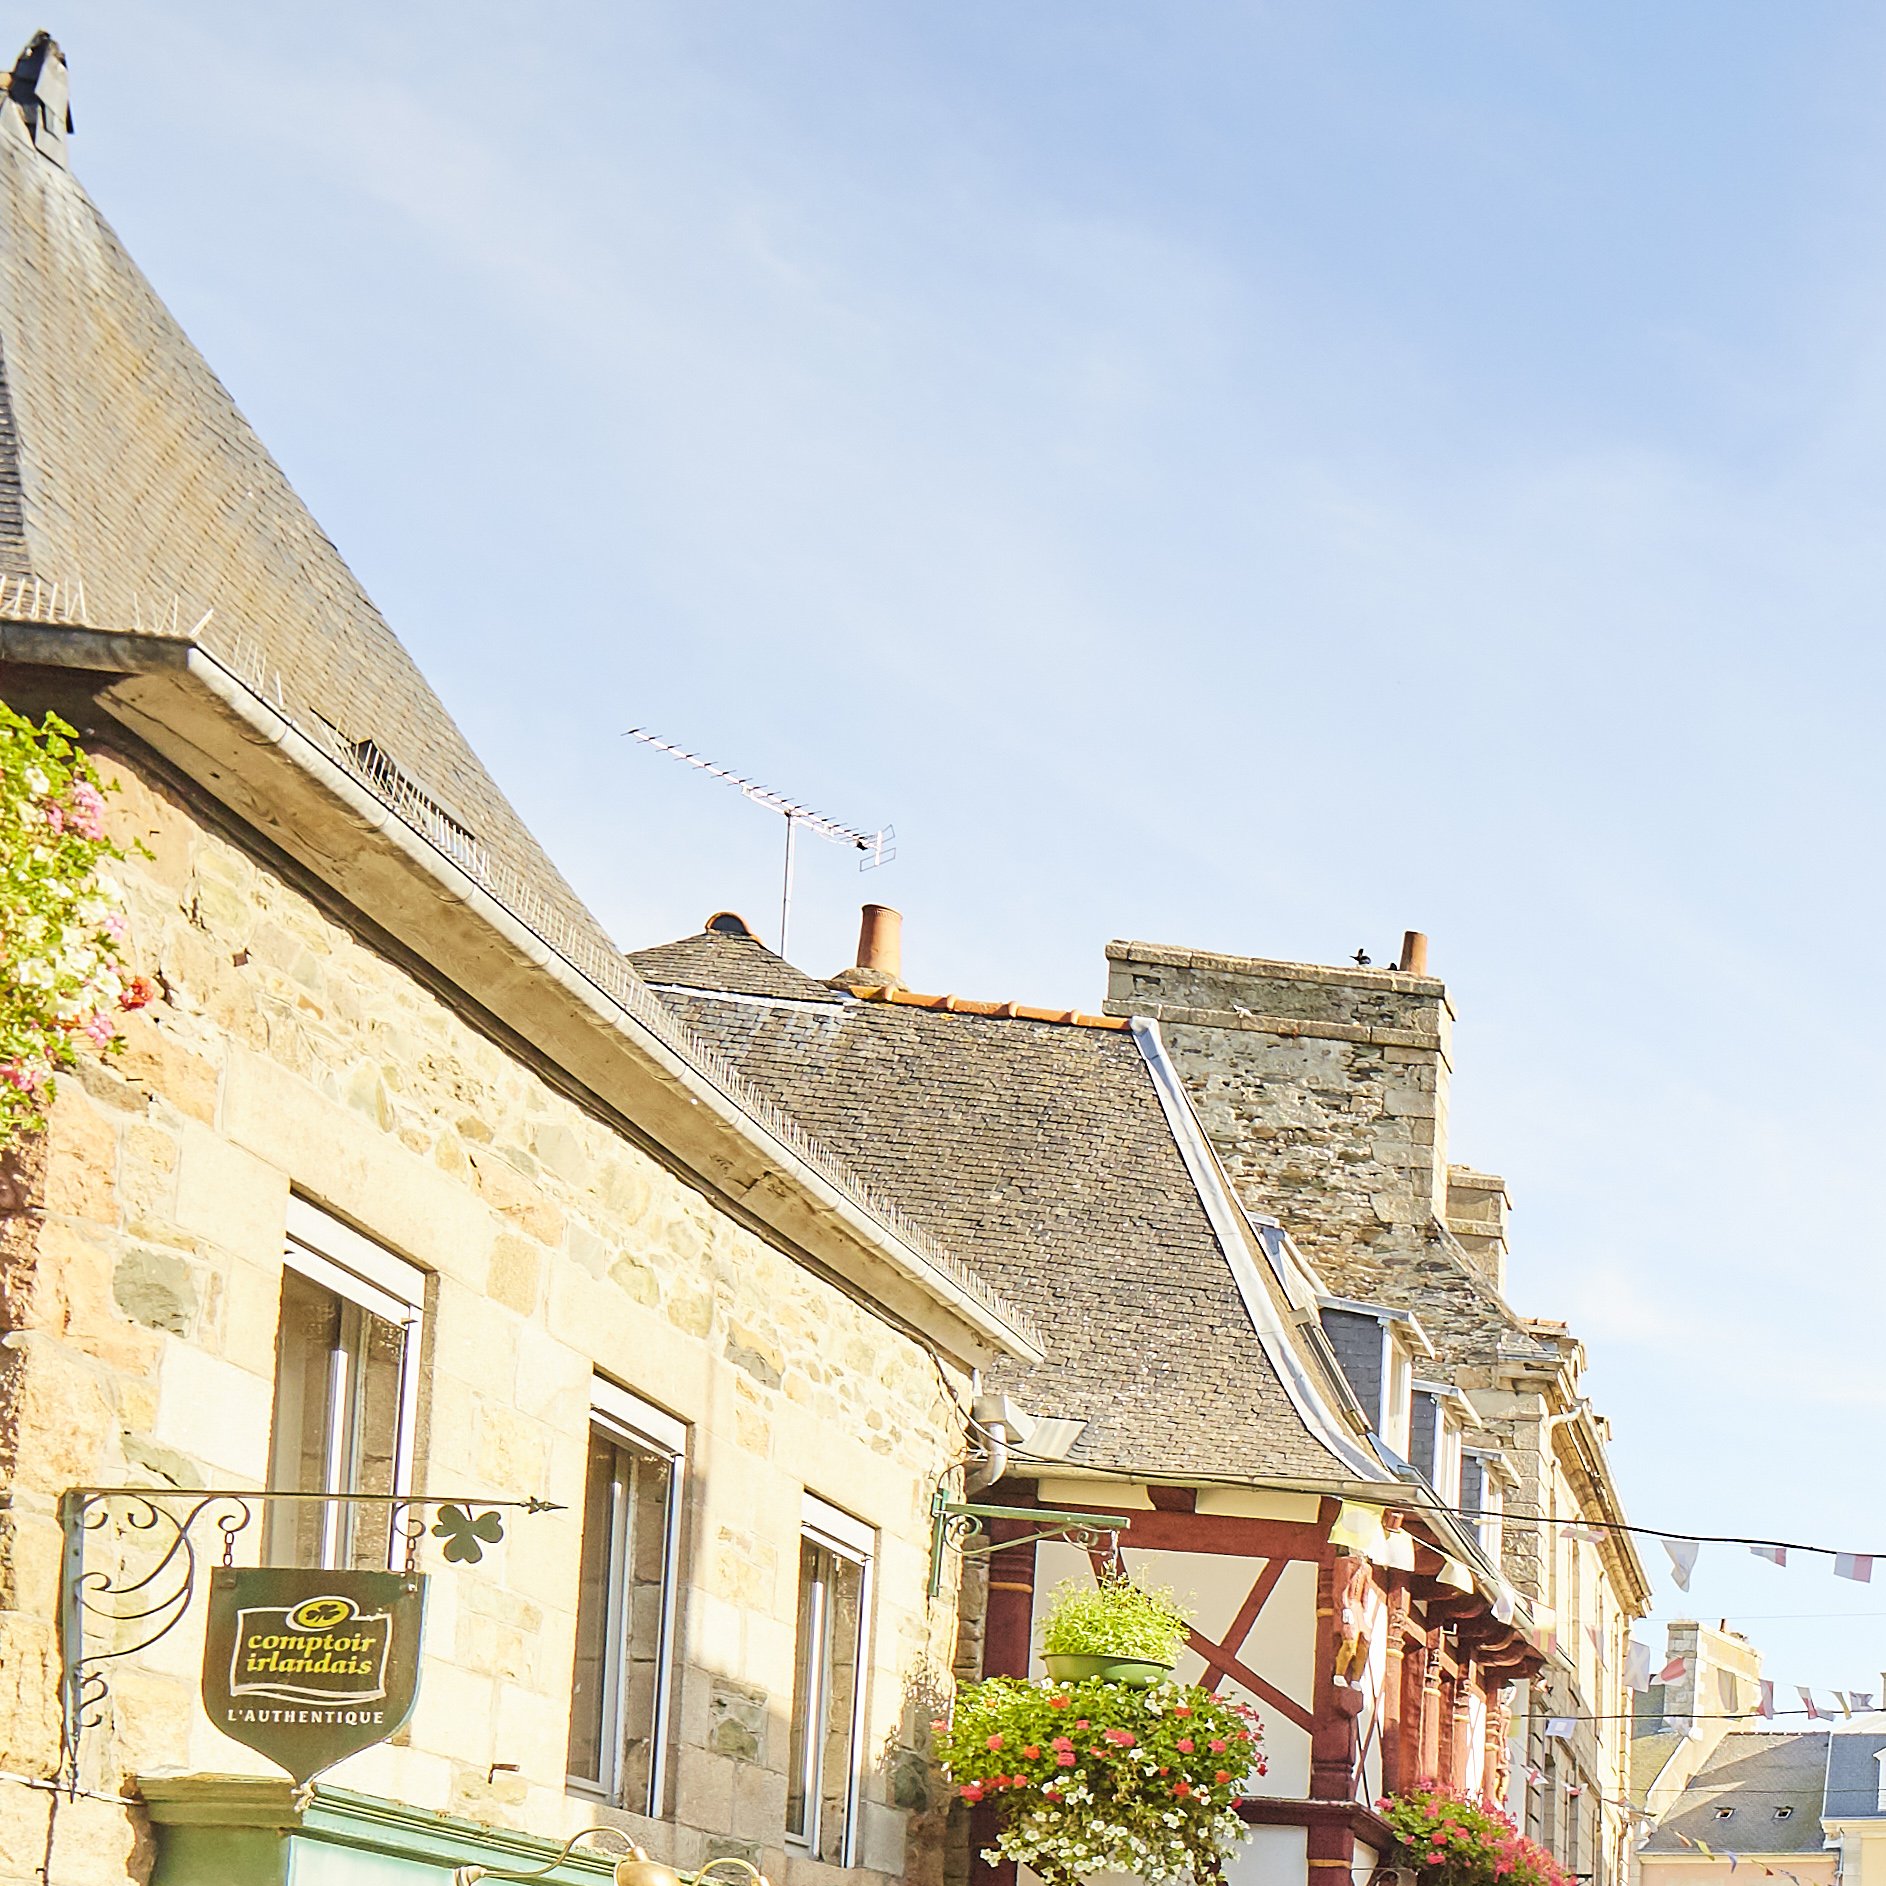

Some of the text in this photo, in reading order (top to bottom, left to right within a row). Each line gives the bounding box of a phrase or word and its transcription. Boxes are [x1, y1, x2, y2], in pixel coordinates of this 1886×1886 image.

[248, 1633, 376, 1658] comptoir
[247, 1651, 372, 1675] irlandais
[228, 1709, 384, 1725] L'AUTHENTIQUE
